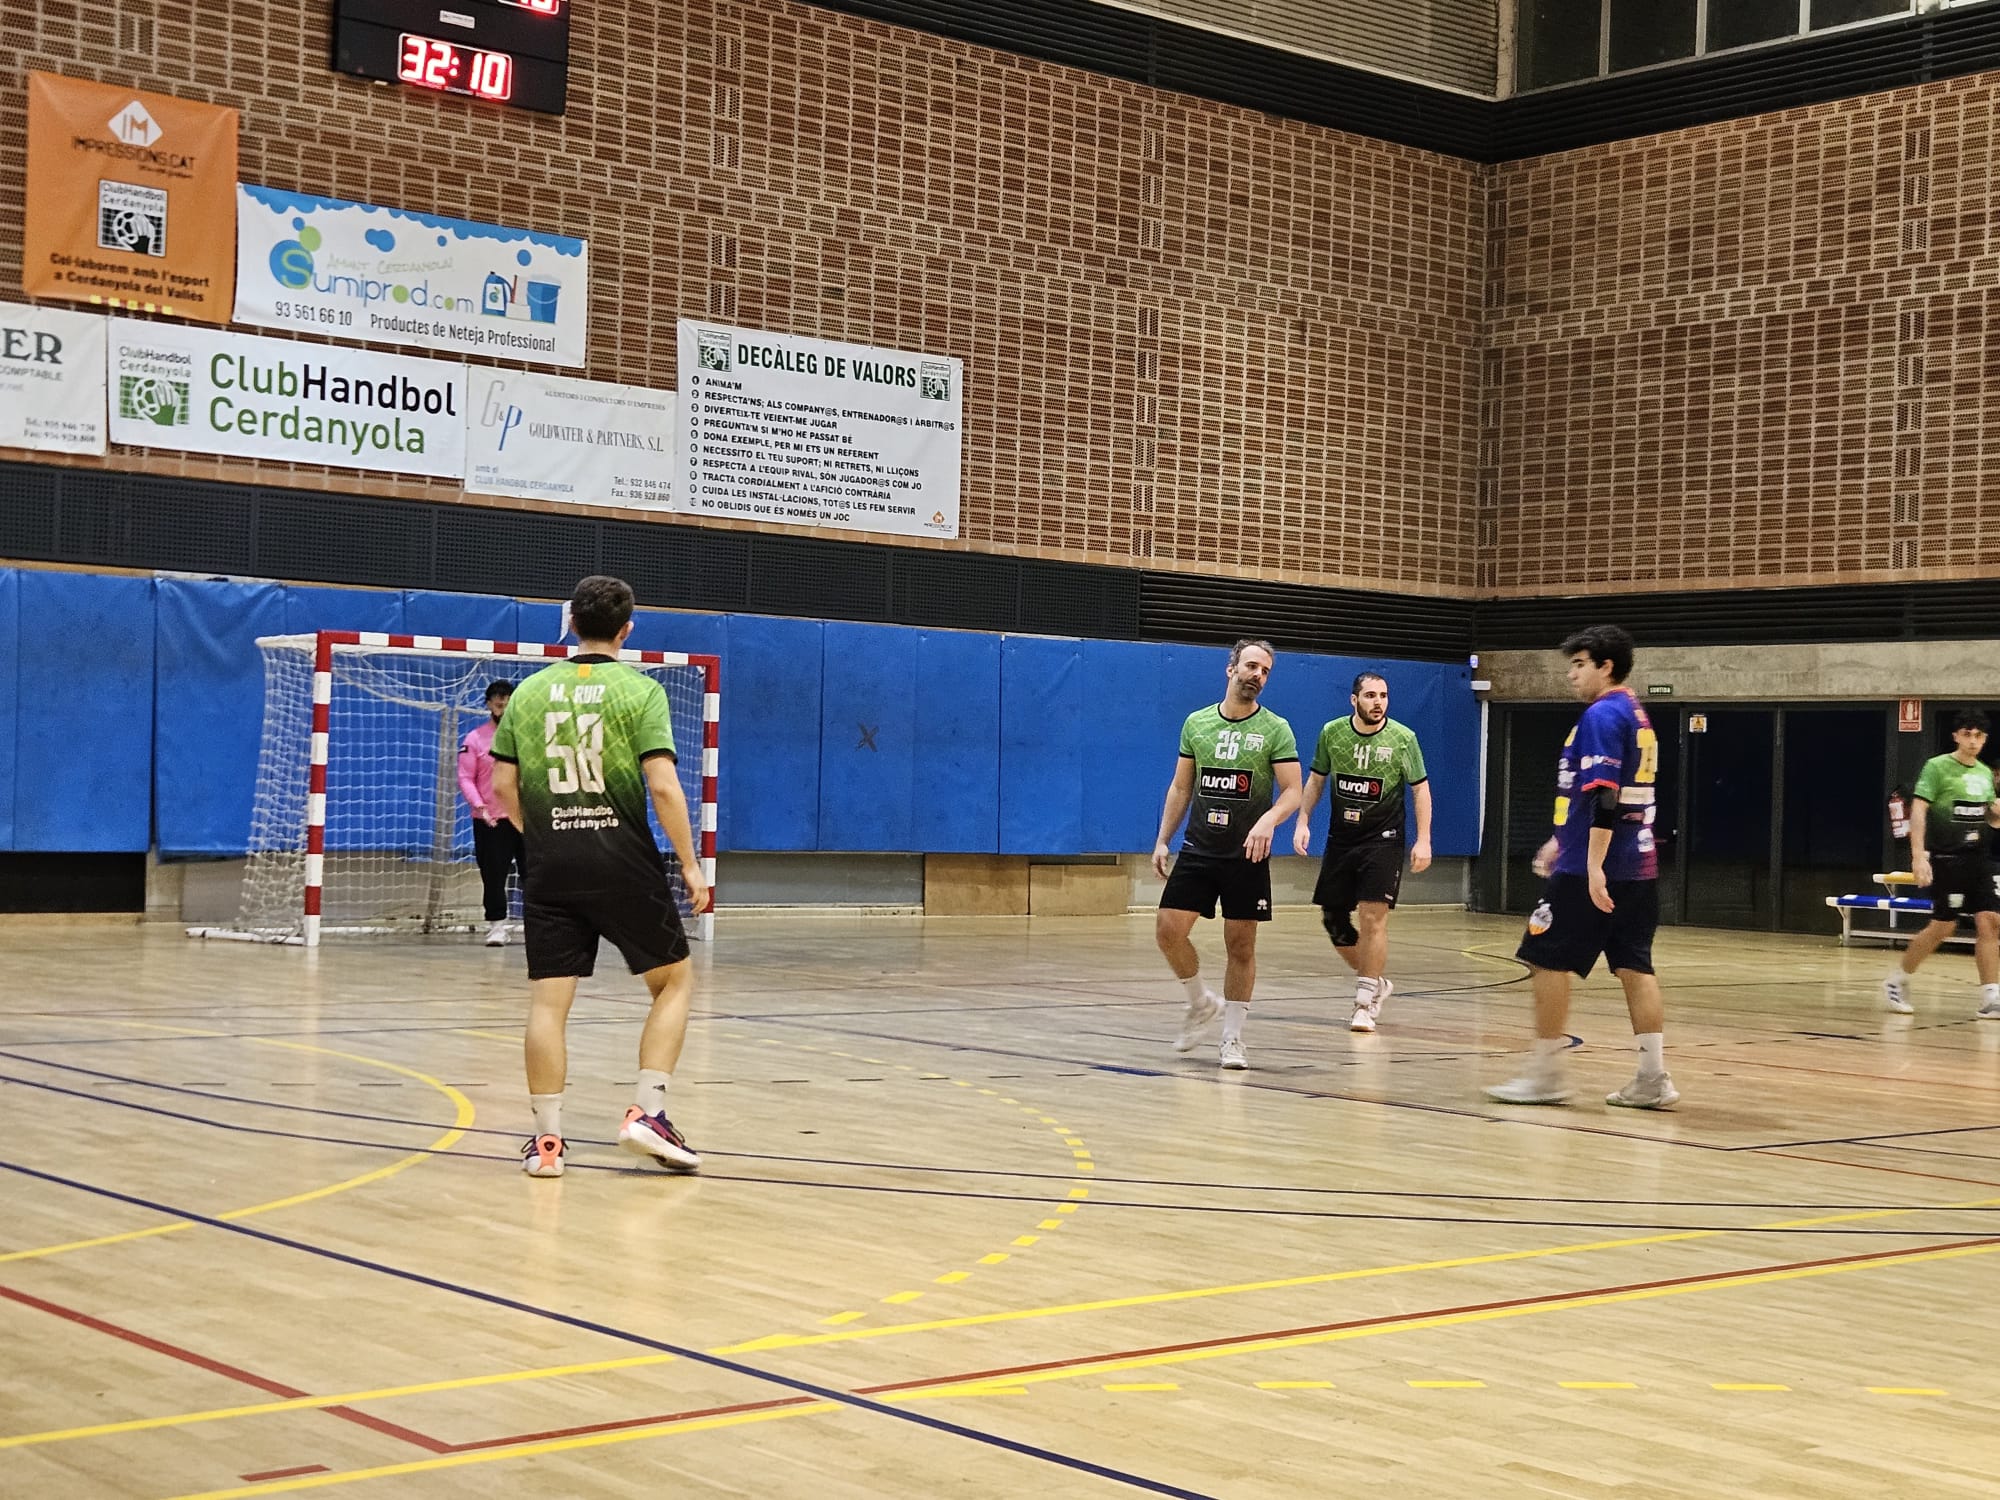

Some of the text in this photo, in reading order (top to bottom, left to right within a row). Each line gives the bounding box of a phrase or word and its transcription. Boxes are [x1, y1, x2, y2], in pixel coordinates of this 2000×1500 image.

[401, 37, 507, 95] 32:10
[102, 183, 166, 201] ClubHandbol
[102, 194, 164, 213] Cerdanyola
[54, 271, 204, 302] a Cerdanyola del Vallès
[133, 267, 158, 280] amb
[162, 270, 209, 288] l'esport
[282, 250, 474, 314] Sumiprod.com
[275, 301, 352, 326] 93 561 66 10
[371, 313, 556, 352] Productes de Neteja Professional
[120, 346, 192, 365] ClubHandbol
[120, 359, 192, 378] Cerdanyola
[738, 343, 916, 388] DECÀLEG DE VALORS
[210, 353, 456, 416] ClubHandbol
[705, 378, 742, 391] ANIMA'M
[704, 405, 760, 420] DIVERTEIX-TE
[764, 413, 807, 425] VEIENT-ME
[810, 419, 837, 429] JUGAR
[705, 391, 765, 408] RESPECTA'NS;
[767, 400, 782, 409] ALS
[785, 402, 839, 418] COMPANY@S,
[842, 410, 907, 425] ENTRENADOR@S
[915, 417, 955, 431] ÀRBITR@S
[209, 396, 424, 455] Cerdanyola
[529, 422, 664, 452] GOLDWATER & PARTNERS, S.L.
[704, 419, 758, 432] PREGUNTA'M
[761, 426, 768, 434] SI
[772, 428, 793, 437] M'HO
[810, 432, 840, 442] PASSAT
[842, 434, 853, 444] BÉ
[704, 432, 728, 442] DONA
[732, 435, 773, 449] EXEMPLE,
[774, 441, 791, 450] PER
[793, 443, 803, 451] MI
[806, 444, 821, 453] ETS
[823, 446, 835, 455] UN
[837, 448, 879, 460] REFERENT
[703, 446, 753, 459] NECESSITO
[756, 451, 765, 460] EL
[768, 453, 783, 462] TEU
[786, 455, 821, 468] SUPORT;
[823, 460, 832, 468] NI
[835, 461, 873, 474] RETRETS,
[887, 466, 919, 478] LLIÇONS
[703, 459, 746, 471] RESPECTA
[750, 464, 756, 472] A
[759, 465, 790, 476] L'EQUIP
[792, 469, 817, 480] RIVAL,
[820, 471, 836, 480] SÓN
[839, 475, 890, 488] JUGADOR@S
[892, 480, 909, 489] COM
[911, 482, 922, 490] JO
[703, 472, 735, 483] TRACTA
[738, 477, 800, 490] CORDIALMENT
[811, 484, 842, 496] L'AFICIÓ
[845, 488, 891, 500] CONTRÀRIA
[702, 486, 729, 496] CUIDA
[732, 489, 747, 498] LES
[823, 499, 850, 509] TOT@S
[853, 502, 867, 511] LES
[870, 504, 885, 512] FEM
[888, 506, 916, 515] SERVIR
[702, 500, 714, 508] NO
[718, 501, 751, 511] OBLIDIS
[754, 505, 771, 514] QUE
[774, 505, 784, 515] ÉS
[787, 507, 817, 519] NOMÉS
[834, 513, 850, 521] JOC
[550, 683, 605, 704] M. RUIZ
[545, 711, 605, 794] 58
[1215, 730, 1241, 760] 26
[1354, 743, 1371, 770] 41
[1202, 775, 1237, 790] nuroil
[1339, 780, 1369, 794] nuroil
[552, 817, 619, 830] Cerdanyola
